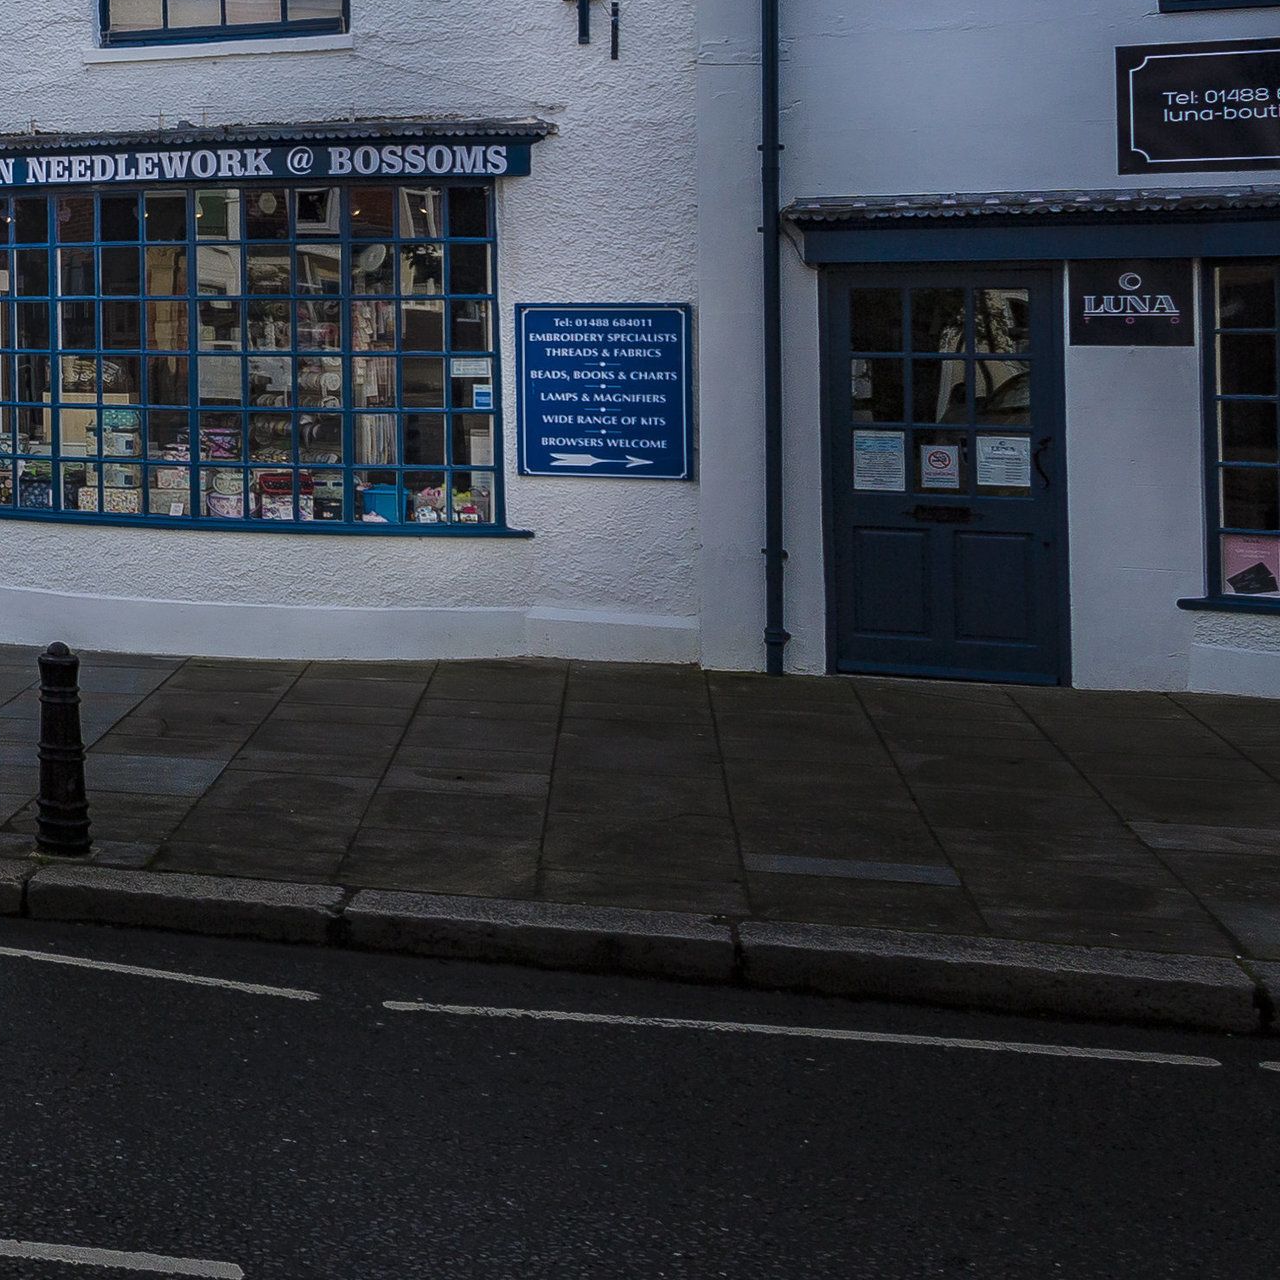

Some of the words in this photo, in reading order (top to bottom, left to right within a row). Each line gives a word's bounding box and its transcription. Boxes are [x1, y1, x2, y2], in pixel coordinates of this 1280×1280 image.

[1162, 90, 1199, 105] Tel:
[1205, 88, 1270, 104] 01488
[26, 148, 274, 184] NEEDLEWORK
[286, 147, 315, 176] @
[328, 145, 509, 176] BOSSOMS
[1083, 295, 1180, 313] LUNA
[553, 317, 572, 327] Tel:
[575, 318, 609, 327] 01488
[612, 318, 653, 327] 684011
[529, 333, 603, 342] EMBROIDERY
[607, 334, 678, 343] SPECIALISTS
[545, 348, 598, 357] THREADS
[601, 348, 610, 357] &
[613, 348, 662, 357] FABRICS
[530, 371, 570, 381] BEADS,
[573, 371, 614, 380] BOOKS
[618, 371, 627, 380] &
[630, 371, 677, 381] CHARTS
[540, 393, 578, 402] LAMPS
[581, 393, 590, 402] &
[593, 393, 666, 403] MAGNIFIERS
[542, 415, 574, 424] WIDE
[577, 415, 618, 425] RANGE
[621, 416, 637, 425] OF
[641, 417, 666, 426] KITS
[541, 437, 604, 447] BROWSERS
[607, 438, 668, 448] WELCOME
